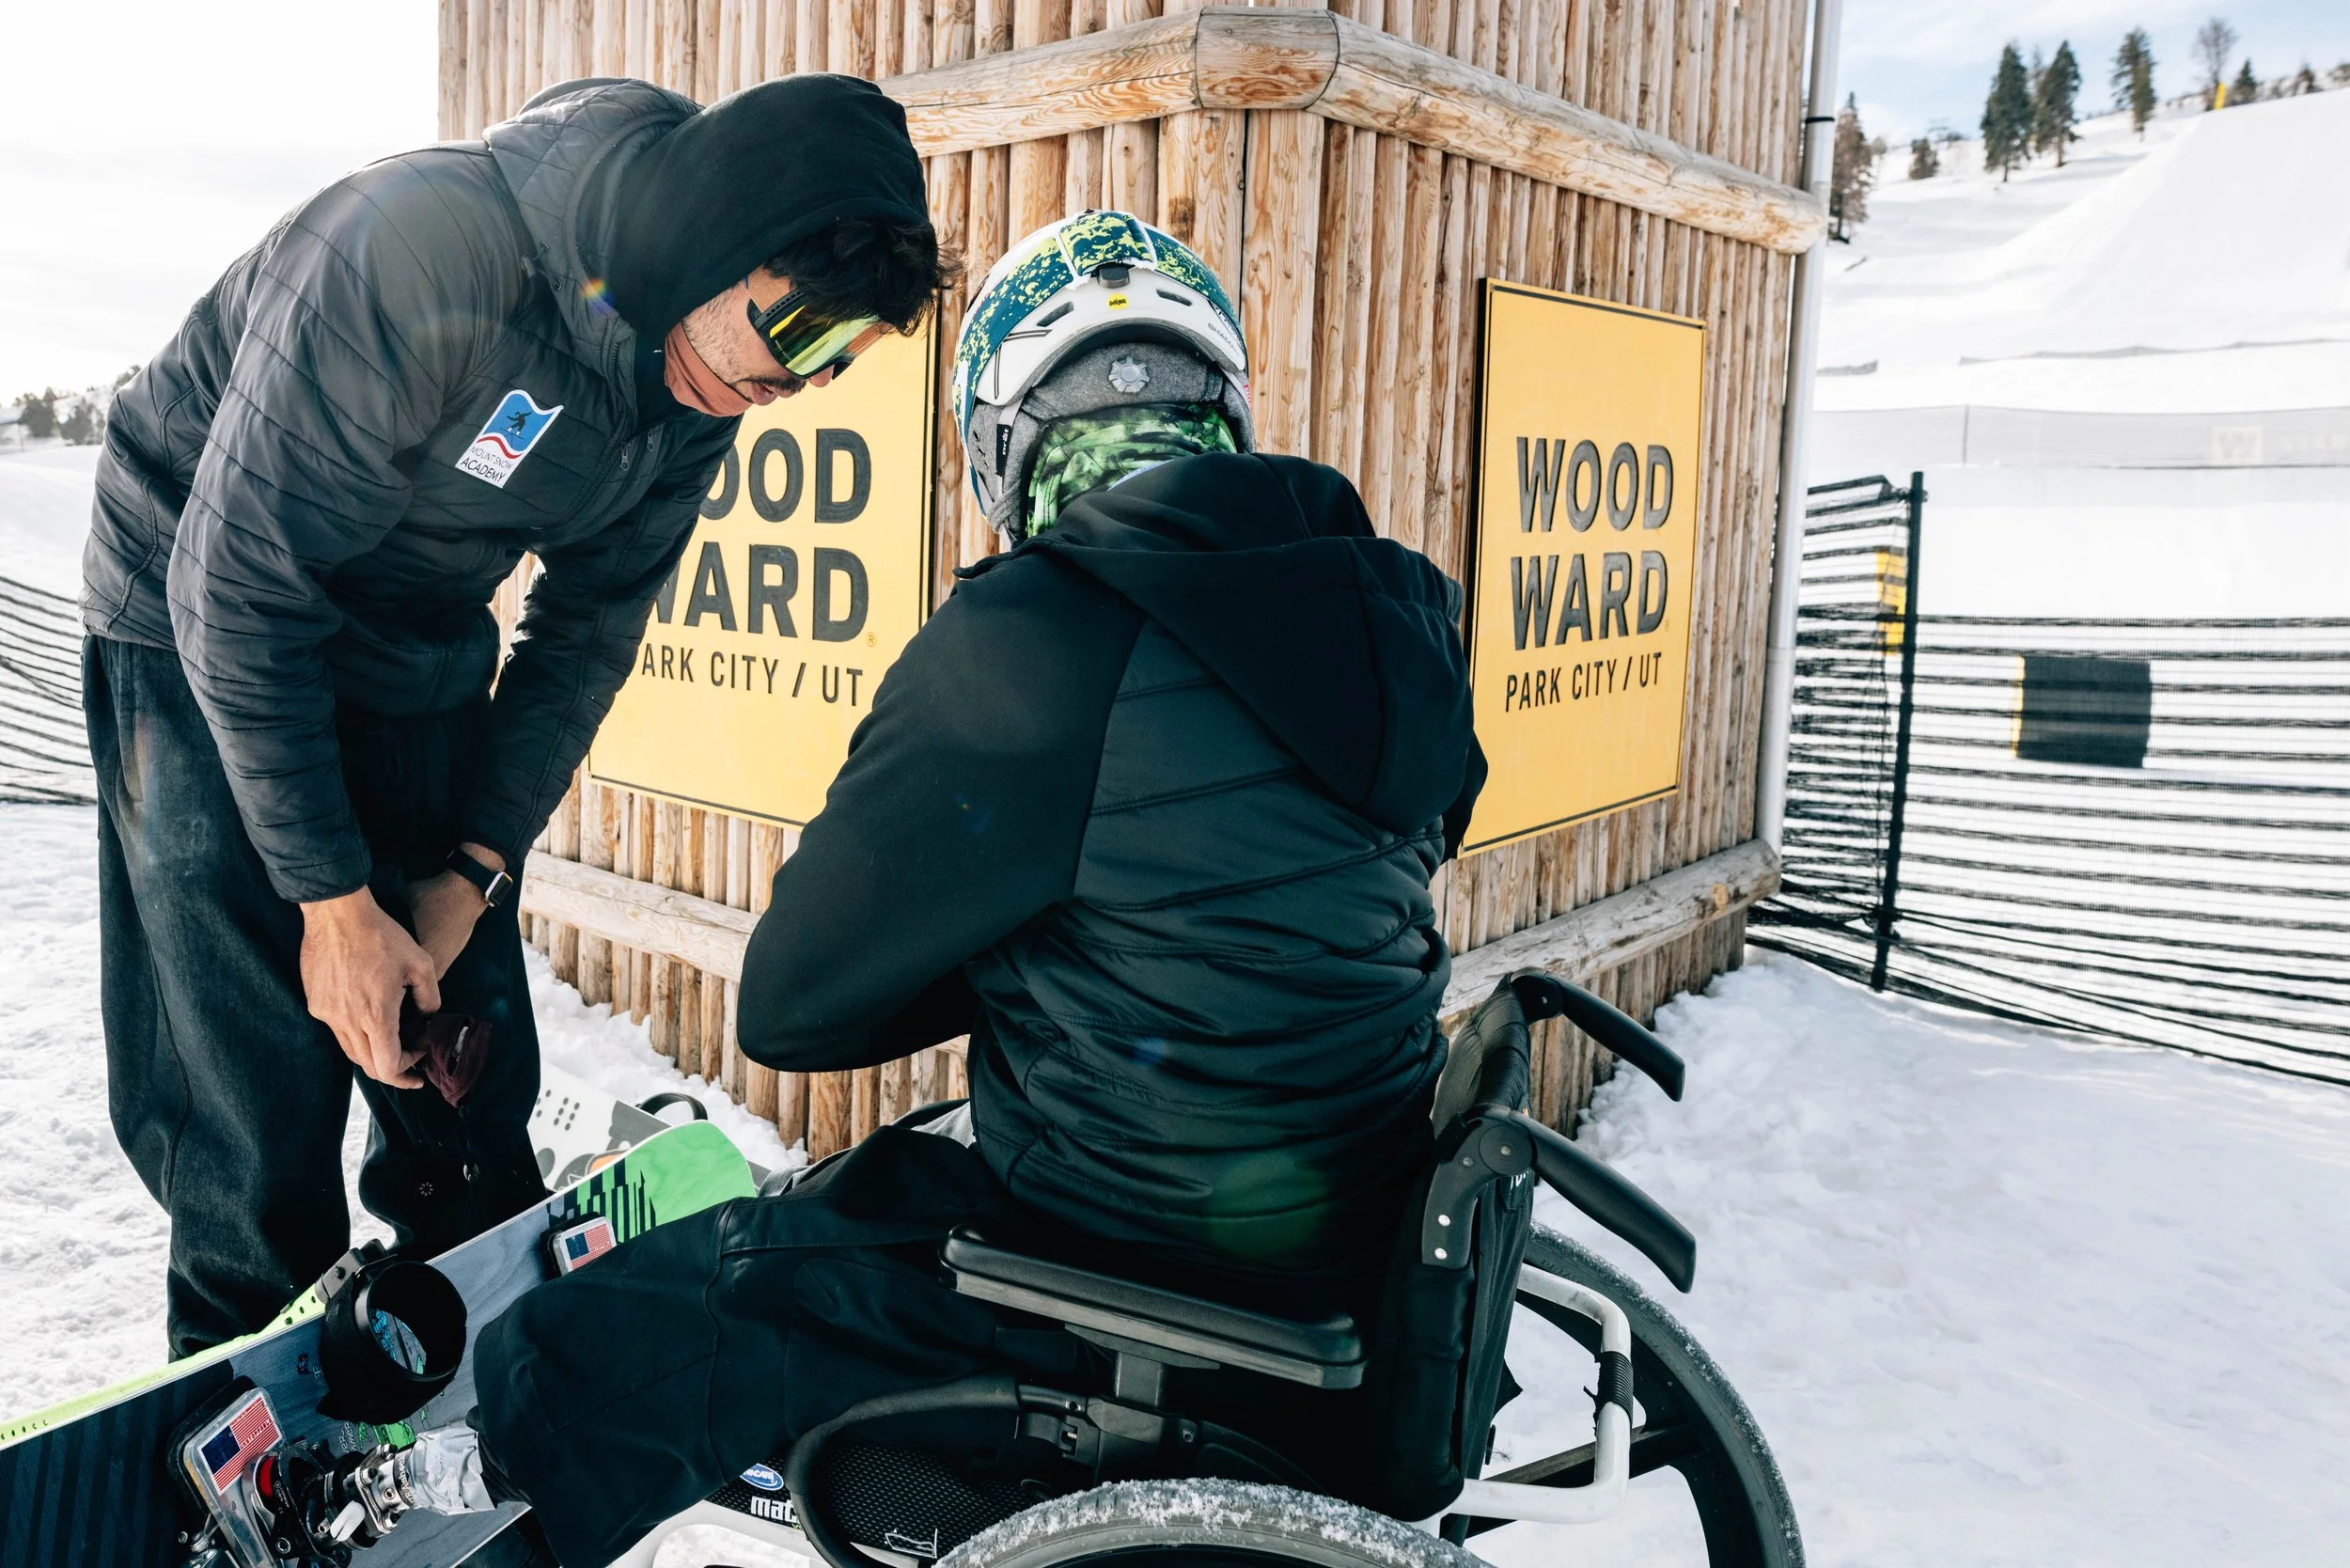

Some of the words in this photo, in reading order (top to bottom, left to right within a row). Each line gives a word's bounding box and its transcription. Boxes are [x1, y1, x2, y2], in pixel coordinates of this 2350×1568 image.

[460, 457, 507, 482] ACADEMY
[470, 446, 495, 462] MOUNT
[494, 456, 514, 469] SNOW
[698, 428, 872, 524] OD
[1516, 436, 1674, 533] WOOD
[655, 541, 870, 643] ARD
[1511, 550, 1668, 651] WARD
[641, 642, 695, 683] ARK
[710, 651, 779, 695] CITY
[821, 665, 864, 707] UT
[1505, 666, 1561, 713] PARK
[1572, 658, 1618, 700] CITY
[1638, 651, 1662, 688] UT
[751, 1496, 797, 1523] mat
